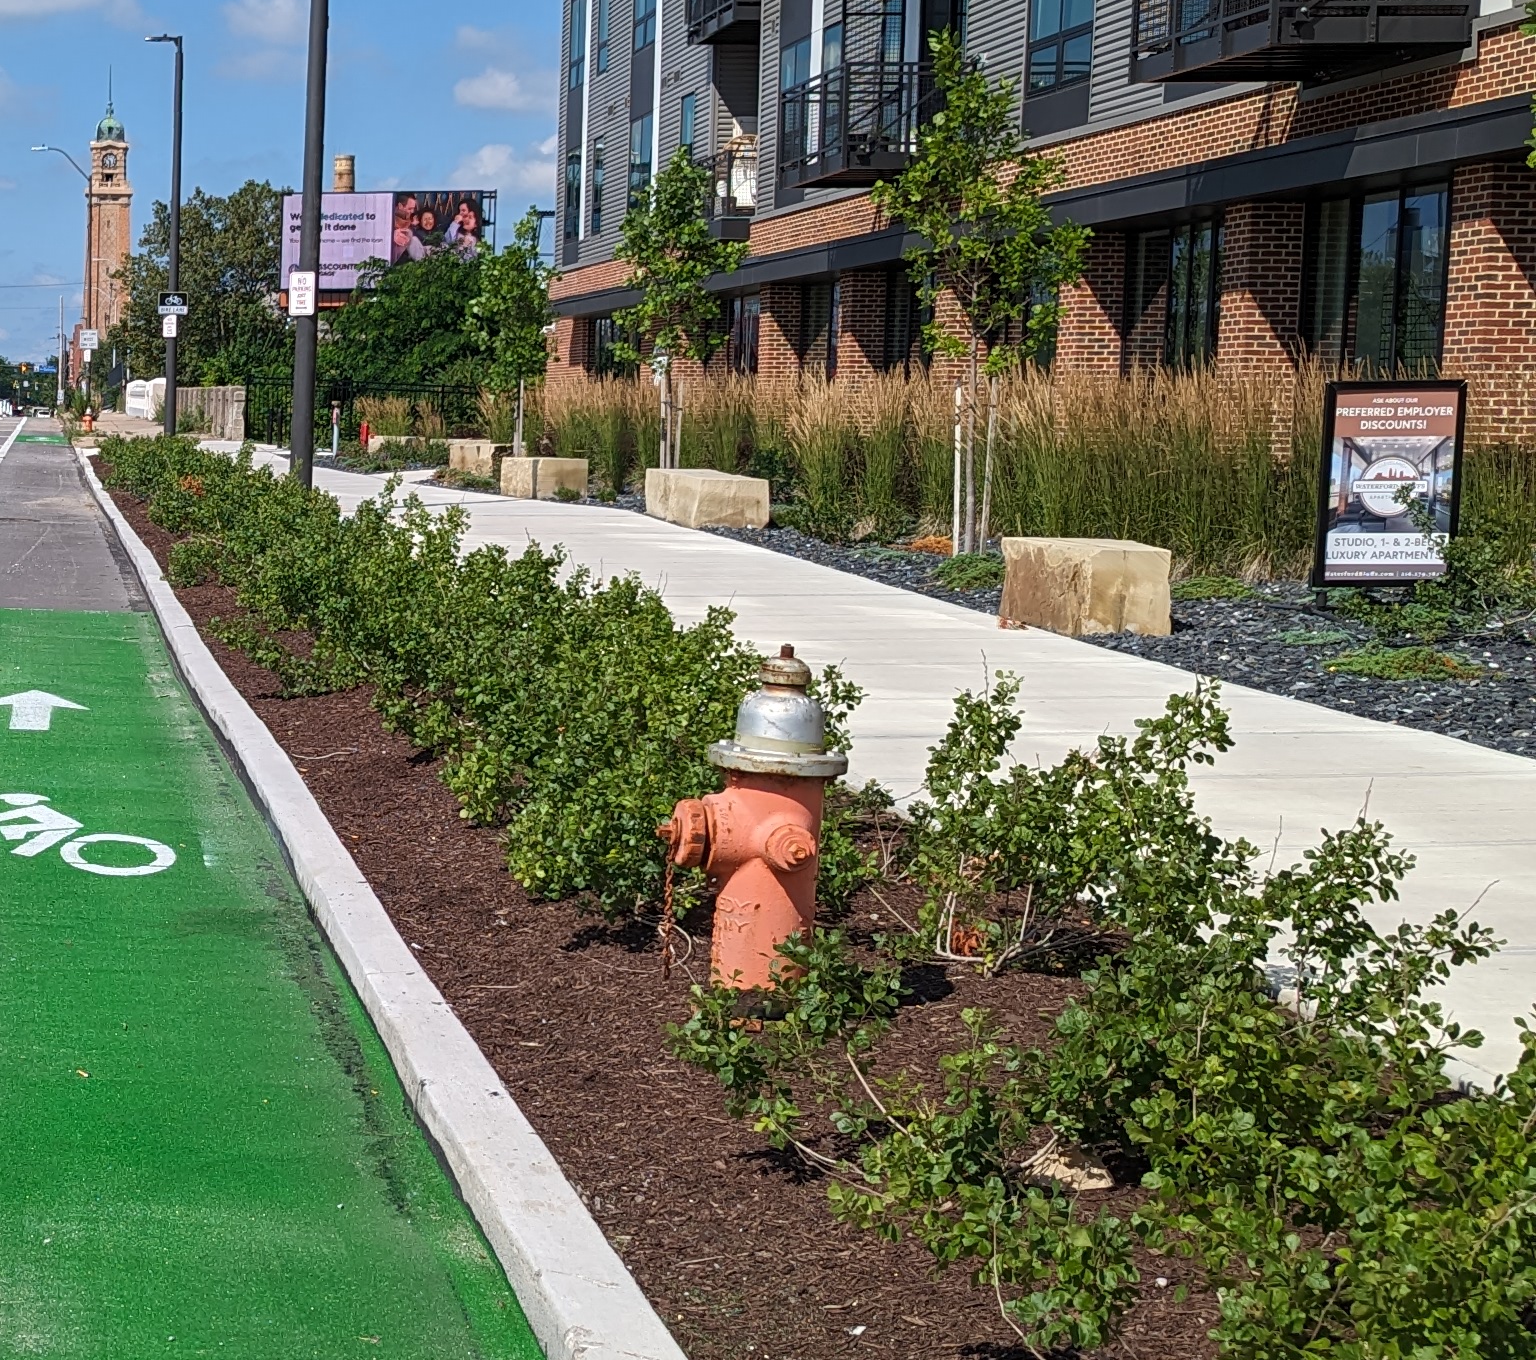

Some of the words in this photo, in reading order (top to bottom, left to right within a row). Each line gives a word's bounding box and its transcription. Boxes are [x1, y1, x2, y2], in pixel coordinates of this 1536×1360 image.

[365, 213, 376, 221] to
[333, 222, 356, 231] done
[1336, 407, 1395, 417] PREFERRED
[1397, 406, 1454, 416] EMPLOYER
[1360, 419, 1427, 430] DISCOUNTS!
[1334, 538, 1378, 548] STUDIO,
[1381, 538, 1390, 547] 1-
[1392, 538, 1400, 547] &
[1325, 551, 1368, 560] LUXURY
